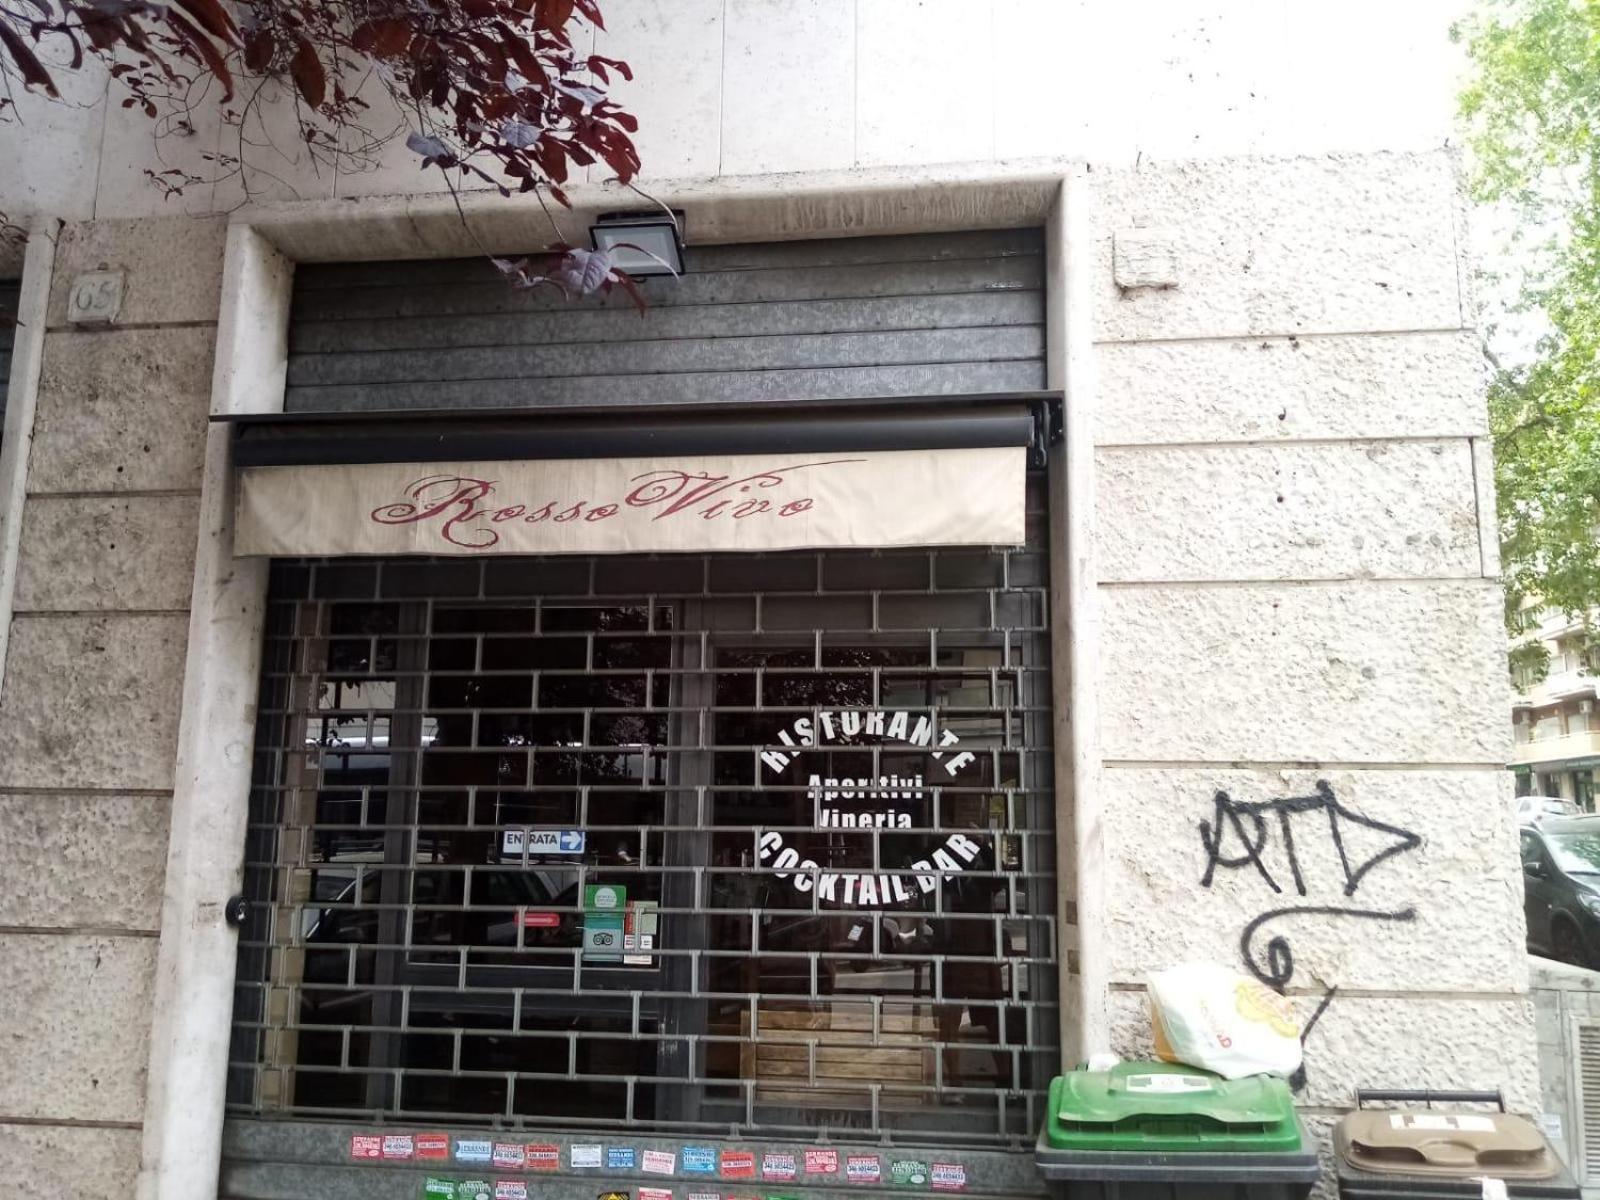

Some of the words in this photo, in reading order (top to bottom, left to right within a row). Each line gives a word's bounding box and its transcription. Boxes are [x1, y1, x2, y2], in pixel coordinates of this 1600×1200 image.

[371, 475, 619, 549] Rosso
[625, 458, 868, 521] Vivo
[506, 833, 558, 845] ENRATA
[760, 832, 911, 906] COCKTAIL
[912, 833, 981, 894] BAR
